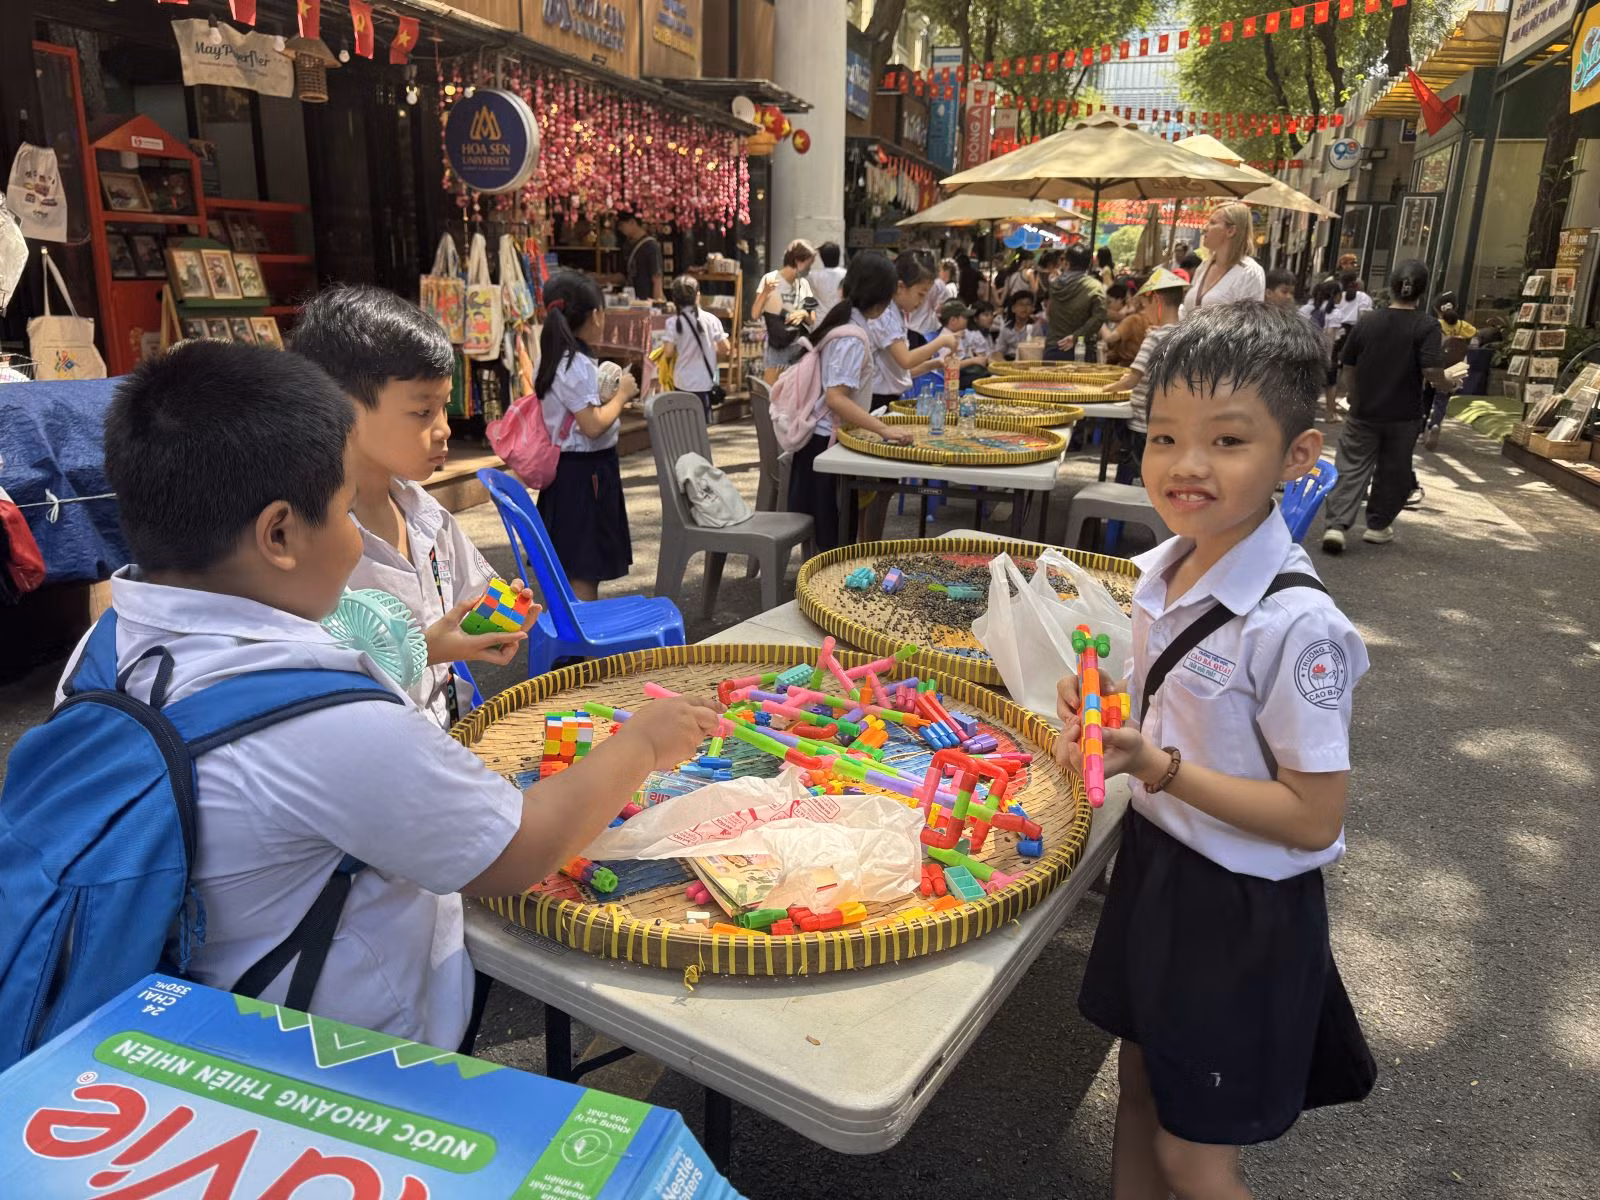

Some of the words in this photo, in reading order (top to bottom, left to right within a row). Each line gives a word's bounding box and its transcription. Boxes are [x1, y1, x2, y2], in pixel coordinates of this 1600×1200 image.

[462, 143, 488, 155] HOA
[490, 143, 511, 155] SEN
[1309, 691, 1326, 701] CAO
[137, 990, 178, 1007] CHAI
[155, 980, 192, 995] 350ML
[141, 1004, 167, 1017] 24
[114, 1038, 197, 1075] NHIÊN
[193, 1064, 272, 1101] THIÊN
[276, 1092, 392, 1136] KHOÁNG
[393, 1123, 478, 1161] NƯỚC
[678, 1168, 703, 1200] aters
